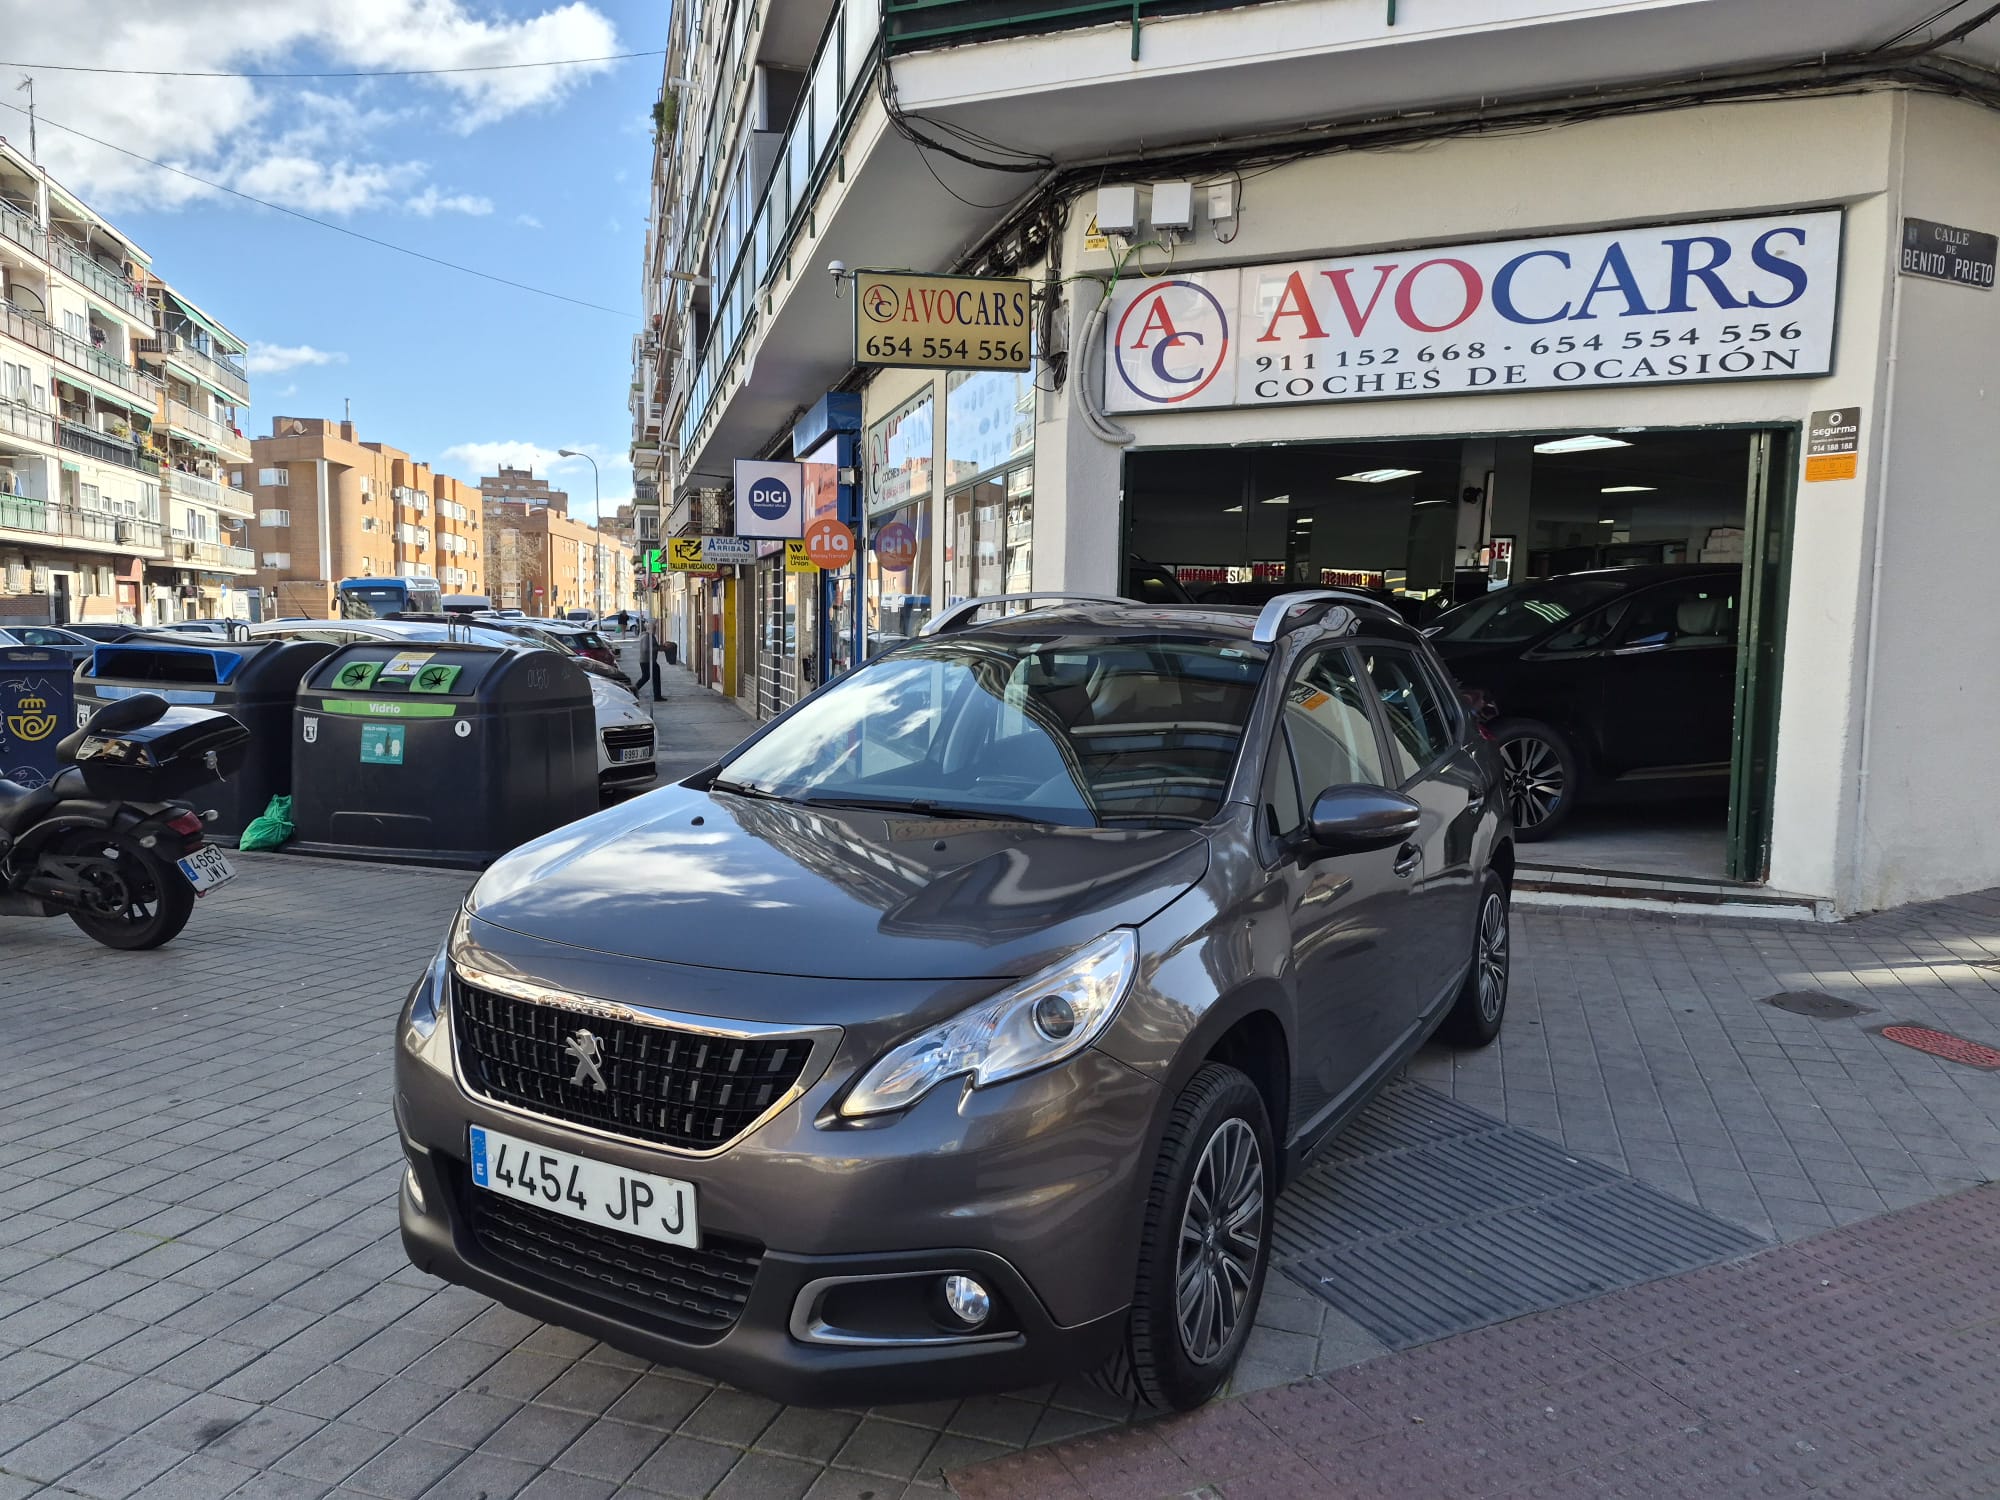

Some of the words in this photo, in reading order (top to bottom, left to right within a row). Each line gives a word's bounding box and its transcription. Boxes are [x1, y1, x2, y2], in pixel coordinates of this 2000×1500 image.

[1934, 227, 1970, 246] CALLE
[1945, 244, 1957, 255] DE
[1903, 248, 1946, 275] BENITO
[1954, 258, 1993, 284] PRIETO
[1256, 227, 1808, 342] AVOCARS
[902, 287, 1024, 328] AVOCARS
[866, 335, 912, 357] 654
[922, 337, 968, 359] 554
[978, 340, 1024, 362] 556
[1256, 352, 1316, 373] 911
[1337, 347, 1400, 368] 152
[1417, 342, 1486, 363] 668
[1530, 334, 1604, 355] 654
[1622, 328, 1701, 349] 554
[1719, 321, 1802, 344] 556
[1255, 369, 1441, 398] COCHES
[1466, 364, 1527, 387] DE
[1553, 345, 1801, 382] OCASIÓN
[1811, 425, 1857, 437] segurma
[1812, 444, 1825, 452] 914
[1827, 443, 1839, 451] 188
[1840, 442, 1853, 450] 188
[753, 490, 787, 504] DIGI
[810, 525, 849, 551] ria
[670, 562, 688, 570] TALLER
[369, 703, 401, 714] Vidrio
[190, 848, 222, 870] 4663
[206, 862, 228, 882] JWV
[476, 1163, 484, 1176] E
[495, 1143, 587, 1211] 4454
[605, 1176, 684, 1235] JPJ
